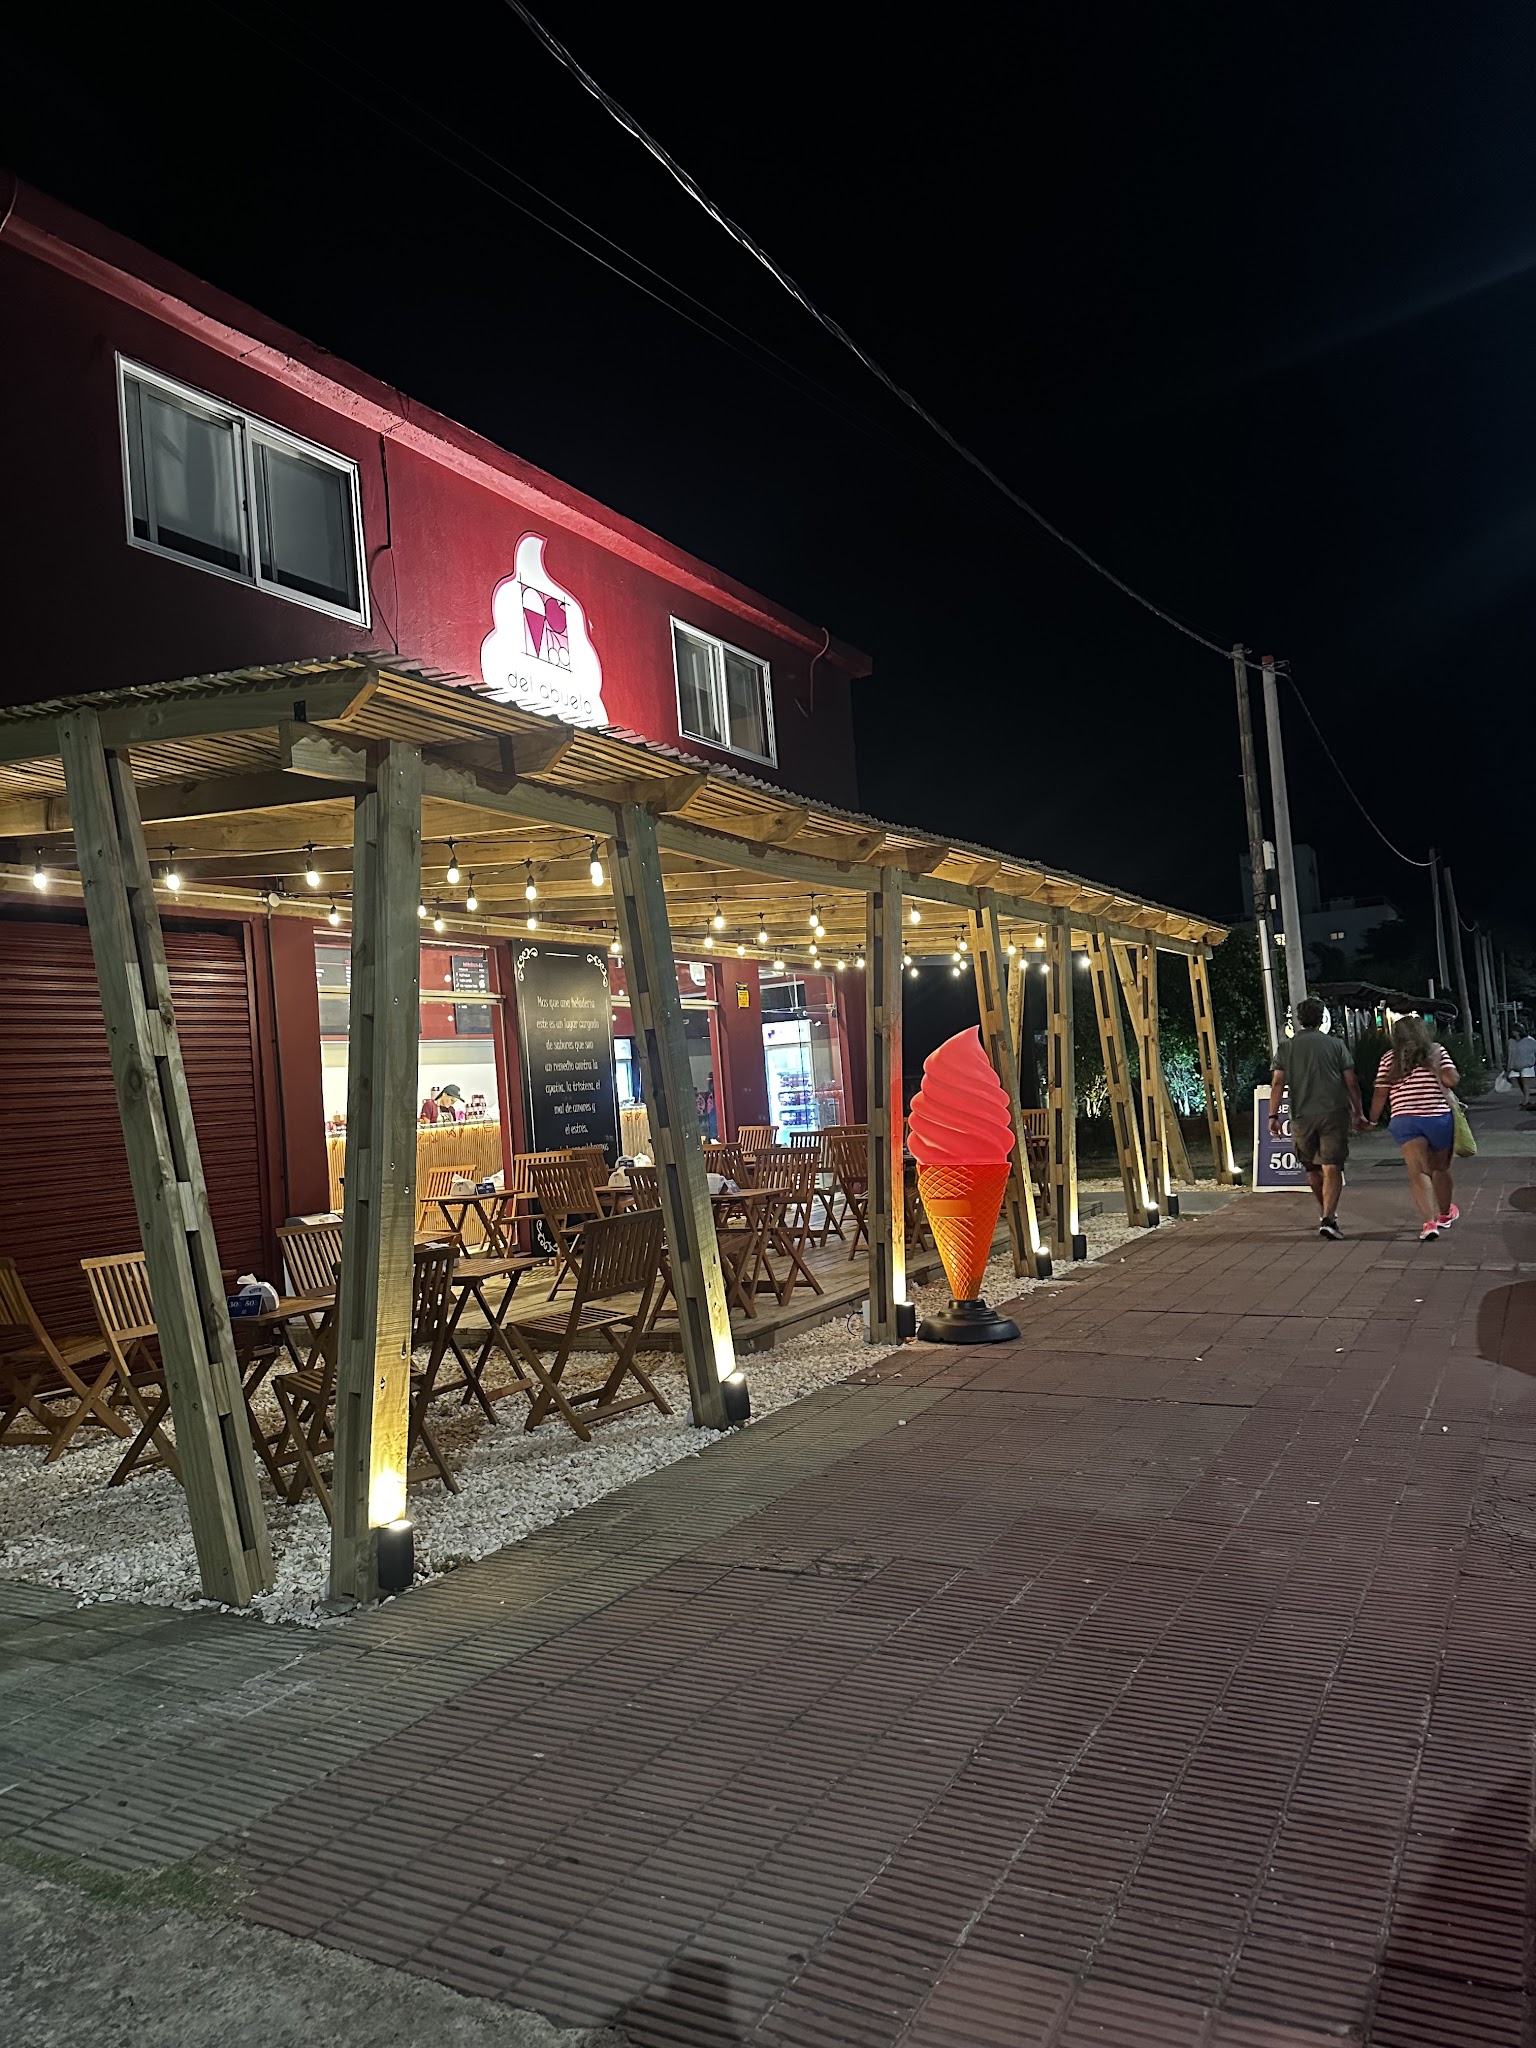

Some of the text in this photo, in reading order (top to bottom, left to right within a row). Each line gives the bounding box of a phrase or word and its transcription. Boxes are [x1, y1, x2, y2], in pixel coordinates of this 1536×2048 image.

[508, 670, 592, 714] del abuelo
[549, 999, 560, 1010] que
[560, 999, 571, 1008] una
[537, 1018, 549, 1029] este
[556, 1020, 564, 1029] un
[564, 1018, 578, 1031] lugar
[579, 1018, 600, 1031] cargado
[546, 1039, 594, 1052] de sabores que son
[545, 1059, 598, 1072] un remedio contra la
[566, 1080, 571, 1092] la
[596, 1079, 601, 1090] el
[554, 1103, 565, 1114] mal
[565, 1102, 572, 1113] de
[572, 1103, 591, 1113] amores
[565, 1123, 570, 1135] el
[1269, 1152, 1296, 1170] 50
